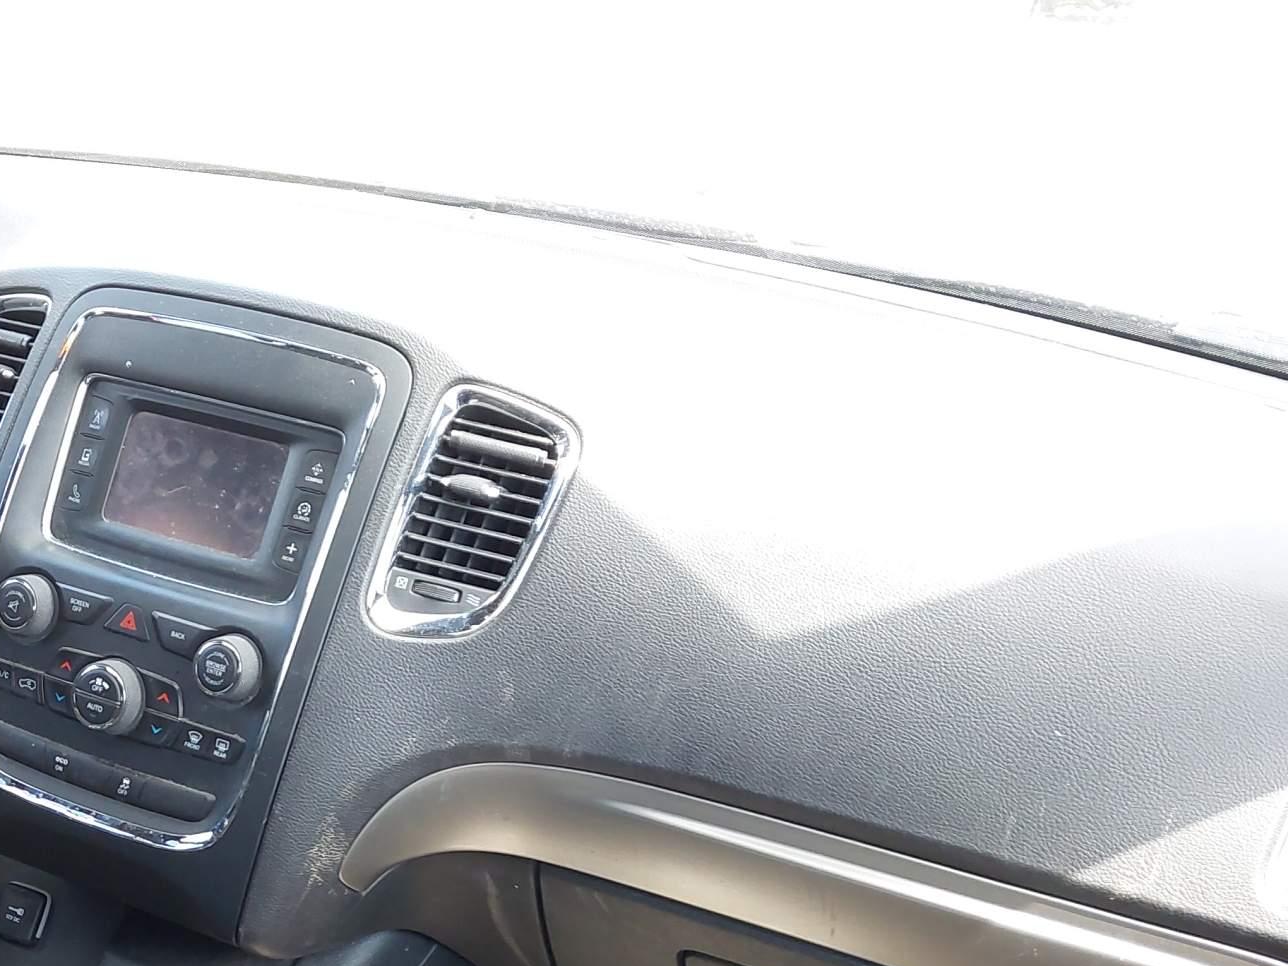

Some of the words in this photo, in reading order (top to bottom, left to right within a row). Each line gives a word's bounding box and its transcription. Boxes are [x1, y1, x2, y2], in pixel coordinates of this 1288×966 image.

[170, 630, 186, 641] BACK
[92, 685, 103, 693] OFF
[86, 702, 104, 713] AUTO
